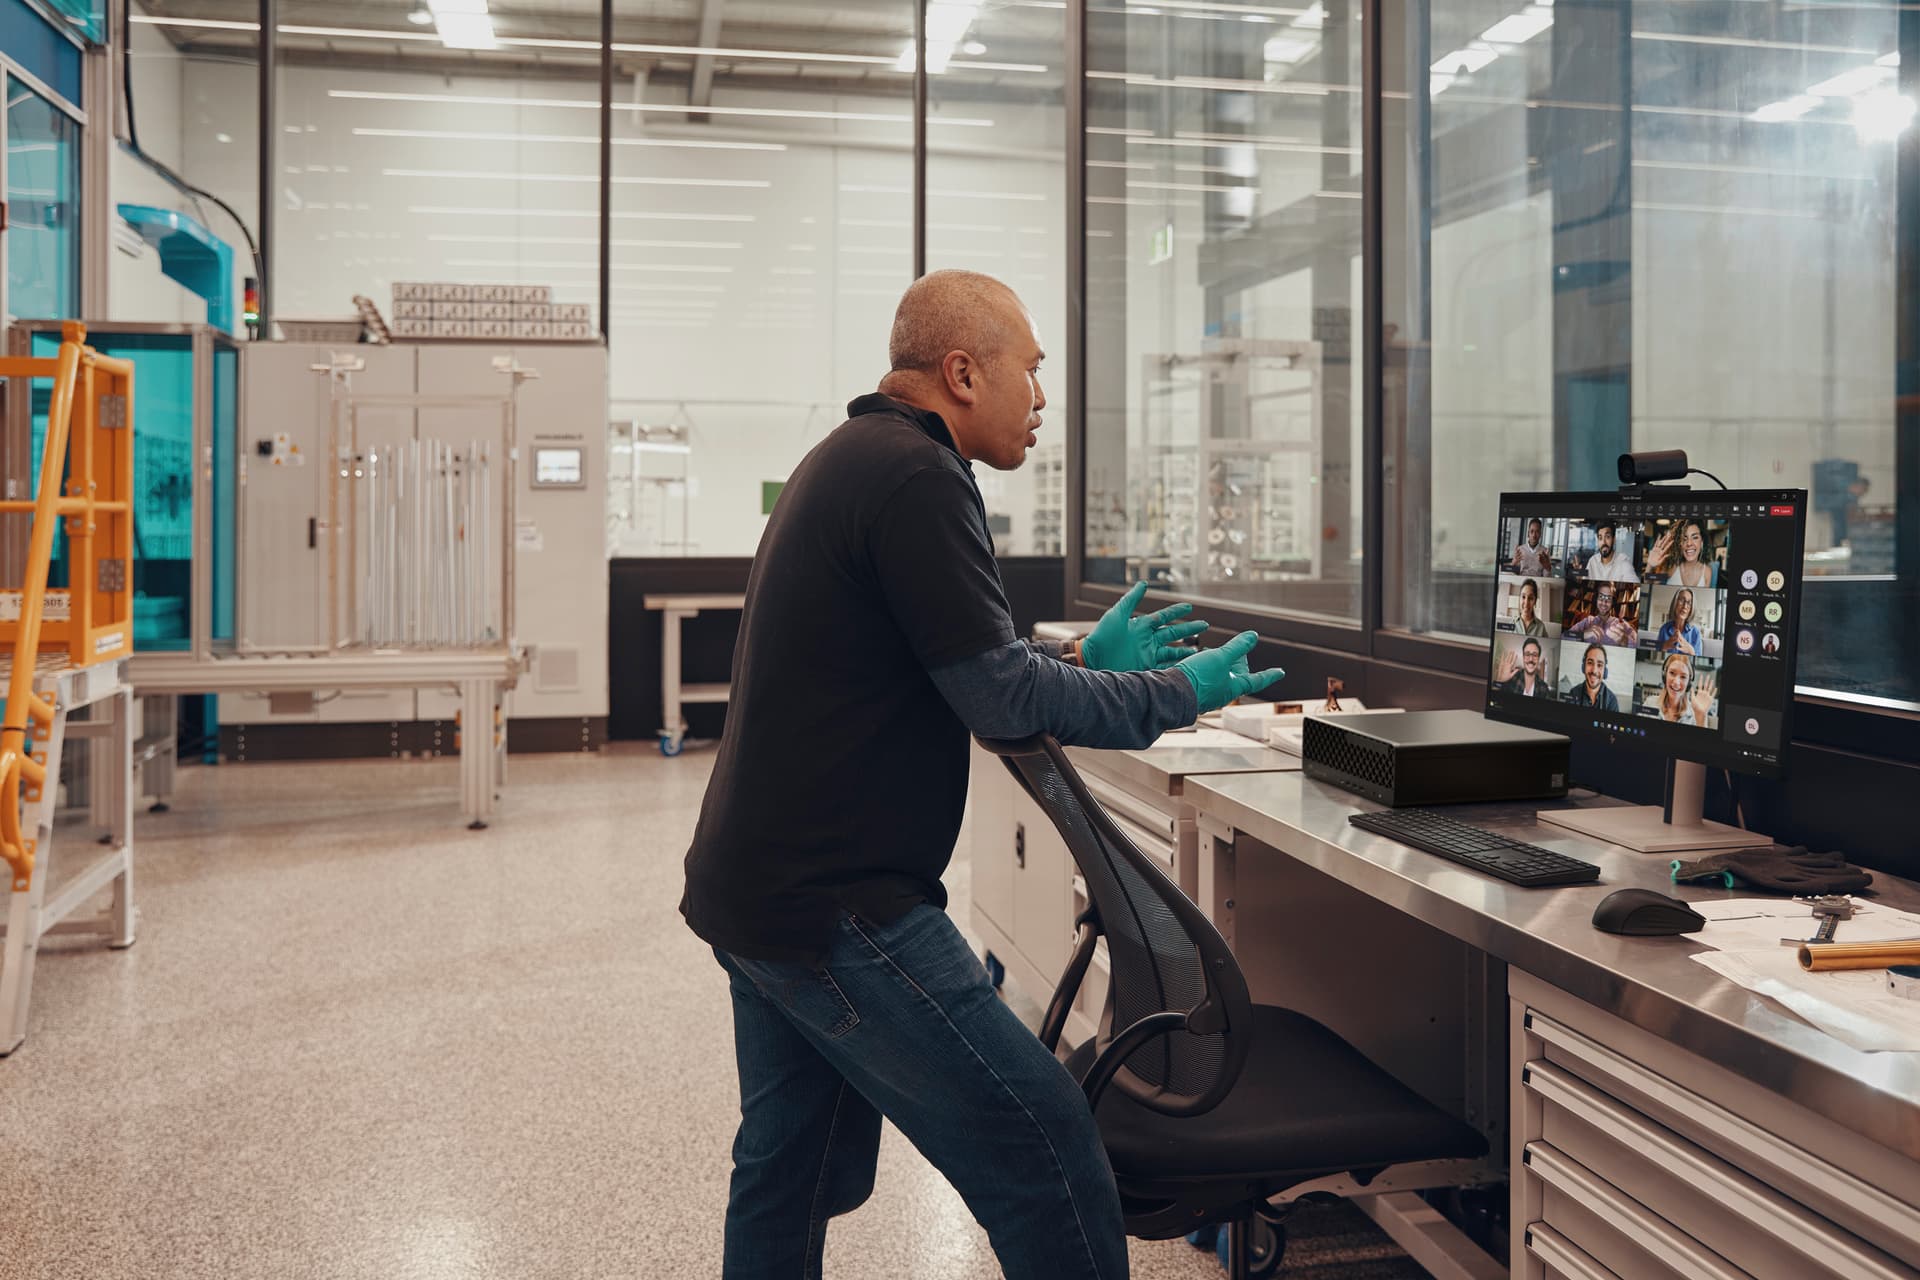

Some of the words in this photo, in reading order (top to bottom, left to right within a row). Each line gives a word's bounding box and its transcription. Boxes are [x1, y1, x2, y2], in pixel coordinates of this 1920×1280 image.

[1770, 577, 1780, 585] SD
[1741, 606, 1753, 614] MR
[1768, 608, 1778, 616] RR
[1740, 636, 1750, 645] NS
